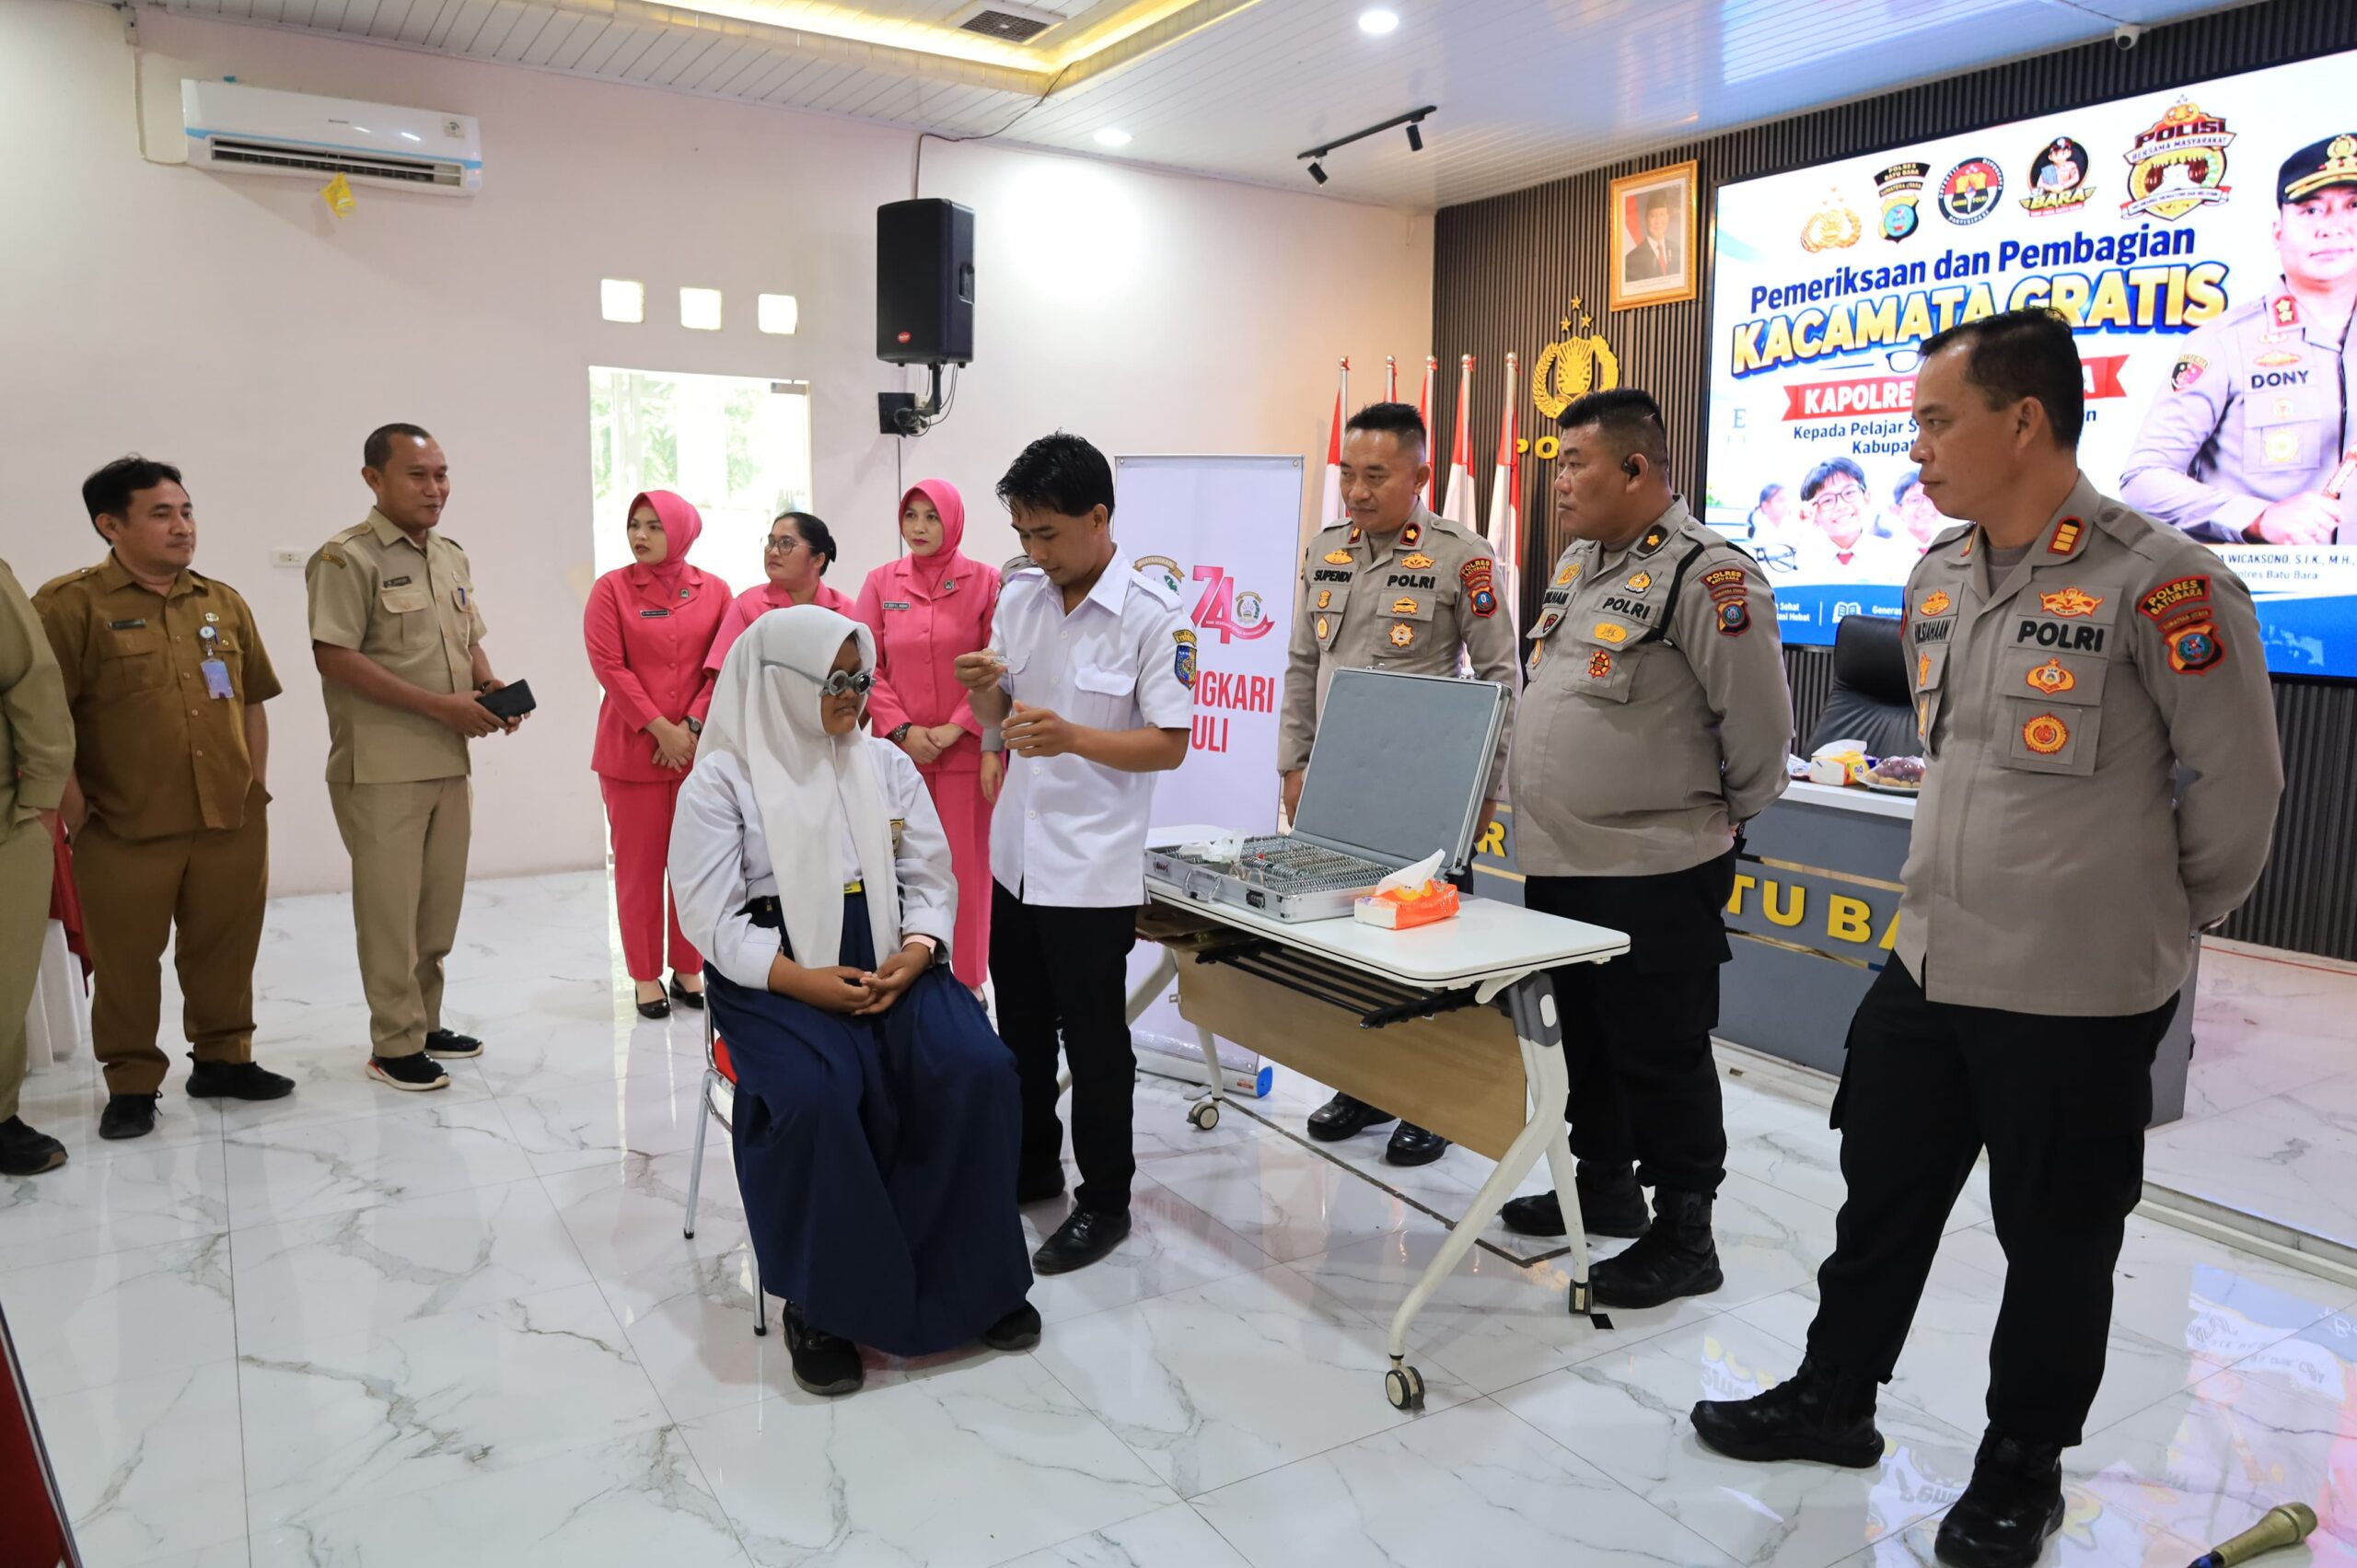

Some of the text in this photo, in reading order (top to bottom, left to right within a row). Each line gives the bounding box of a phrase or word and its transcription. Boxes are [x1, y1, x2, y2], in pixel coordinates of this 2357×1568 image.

[2135, 120, 2225, 148] POLISI
[2132, 143, 2170, 159] BERSAMA
[2029, 188, 2086, 210] BARA
[1751, 223, 2195, 314] Pemeriksaan dan Pembagian
[1732, 261, 2229, 379] KACAMATA GRATIS
[2251, 370, 2309, 389] DONY
[1805, 380, 1914, 414] KAPOLRE
[1794, 424, 1846, 441] Kepada
[1851, 420, 1904, 438] Pelajar
[1909, 421, 1917, 433] S
[1517, 436, 1560, 459] PO
[1852, 440, 1914, 456] Kabupat
[1314, 570, 1353, 583] SUPENDI
[1387, 575, 1435, 589] POLRI
[1706, 570, 1742, 582] POLRES
[1190, 565, 1234, 644] 74
[2148, 580, 2198, 606] POLRES
[2151, 588, 2203, 615] BATUBARA
[1602, 598, 1650, 620] POLRI
[1872, 605, 1903, 615] Generas
[2016, 621, 2104, 653] POLRI
[1191, 714, 1228, 753] ULI
[1727, 874, 1901, 950] TU B
